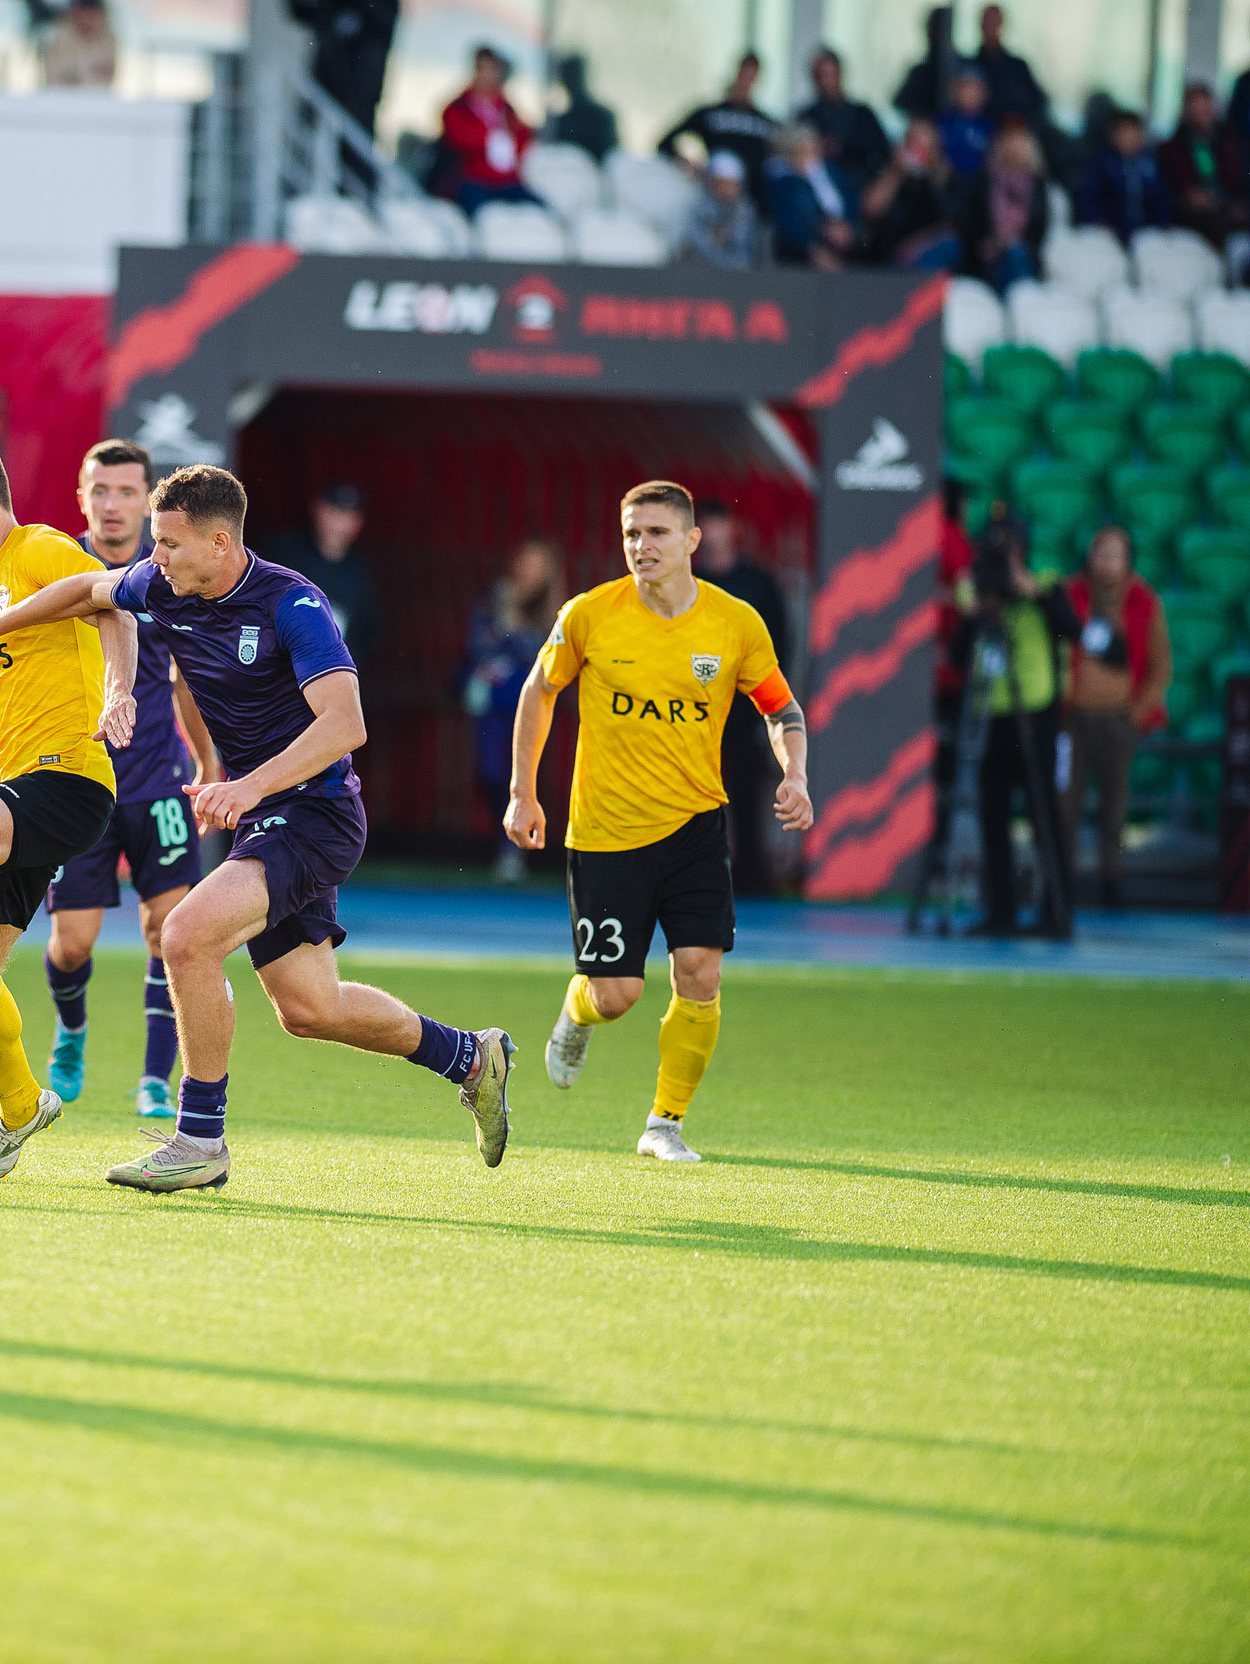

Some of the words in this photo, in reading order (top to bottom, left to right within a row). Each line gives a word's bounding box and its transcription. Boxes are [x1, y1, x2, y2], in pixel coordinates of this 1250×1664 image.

[612, 691, 709, 723] DARS
[150, 797, 188, 847] 18
[576, 917, 626, 963] 23
